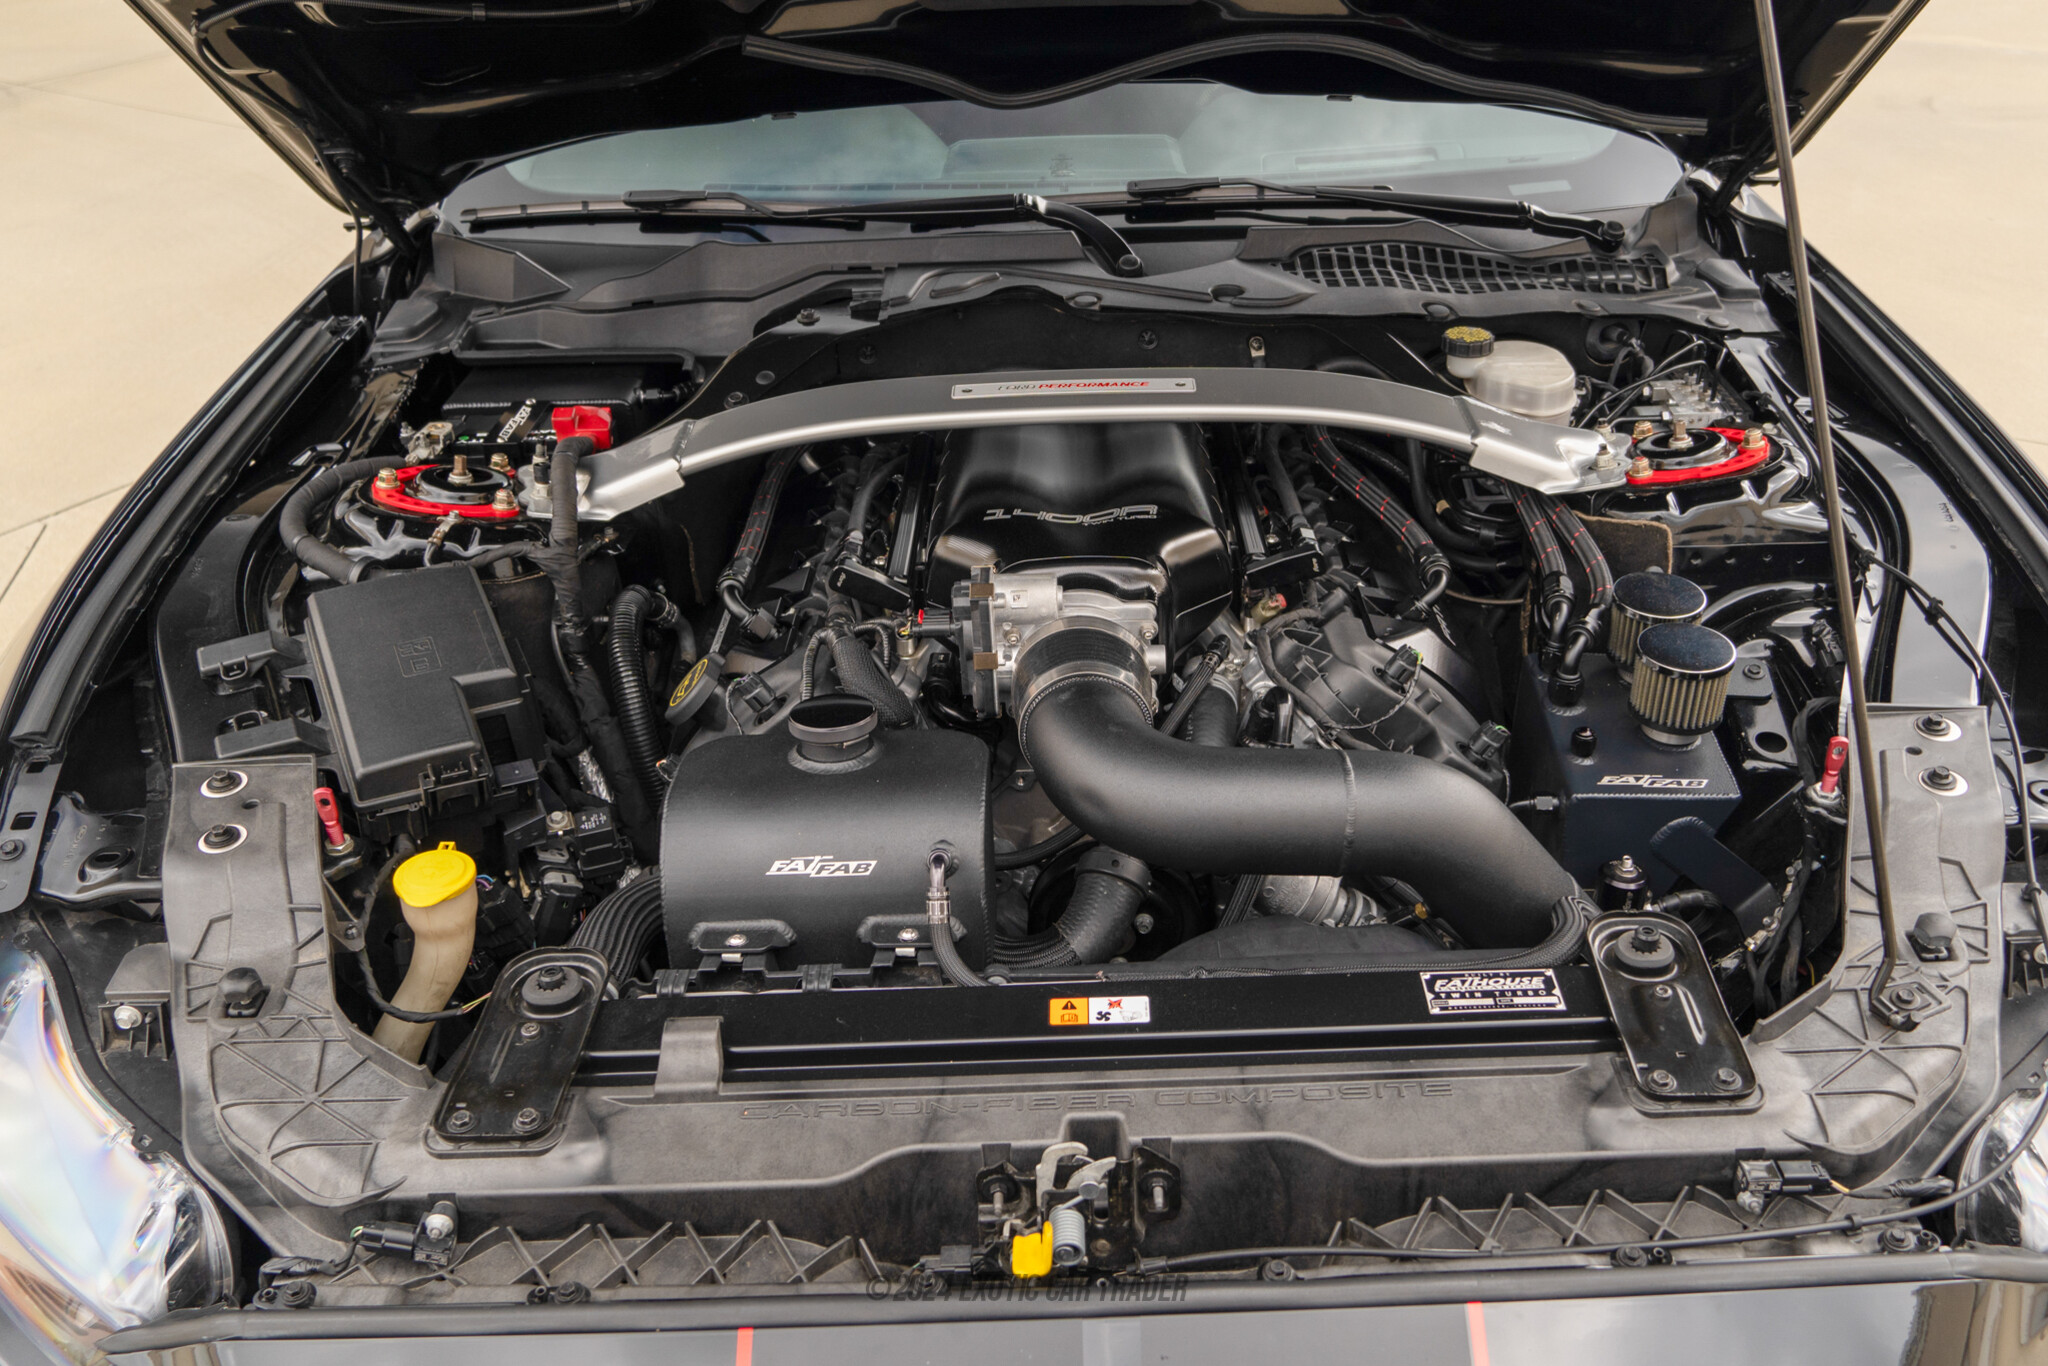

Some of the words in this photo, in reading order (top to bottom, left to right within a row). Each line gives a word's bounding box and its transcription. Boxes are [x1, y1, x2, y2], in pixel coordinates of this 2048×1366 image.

[1038, 381, 1151, 389] PERFORMANCE
[1434, 977, 1545, 988] FATHOUSE
[740, 1093, 1135, 1120] CARBON-FIBER
[1155, 1080, 1454, 1106] COMPOSITE
